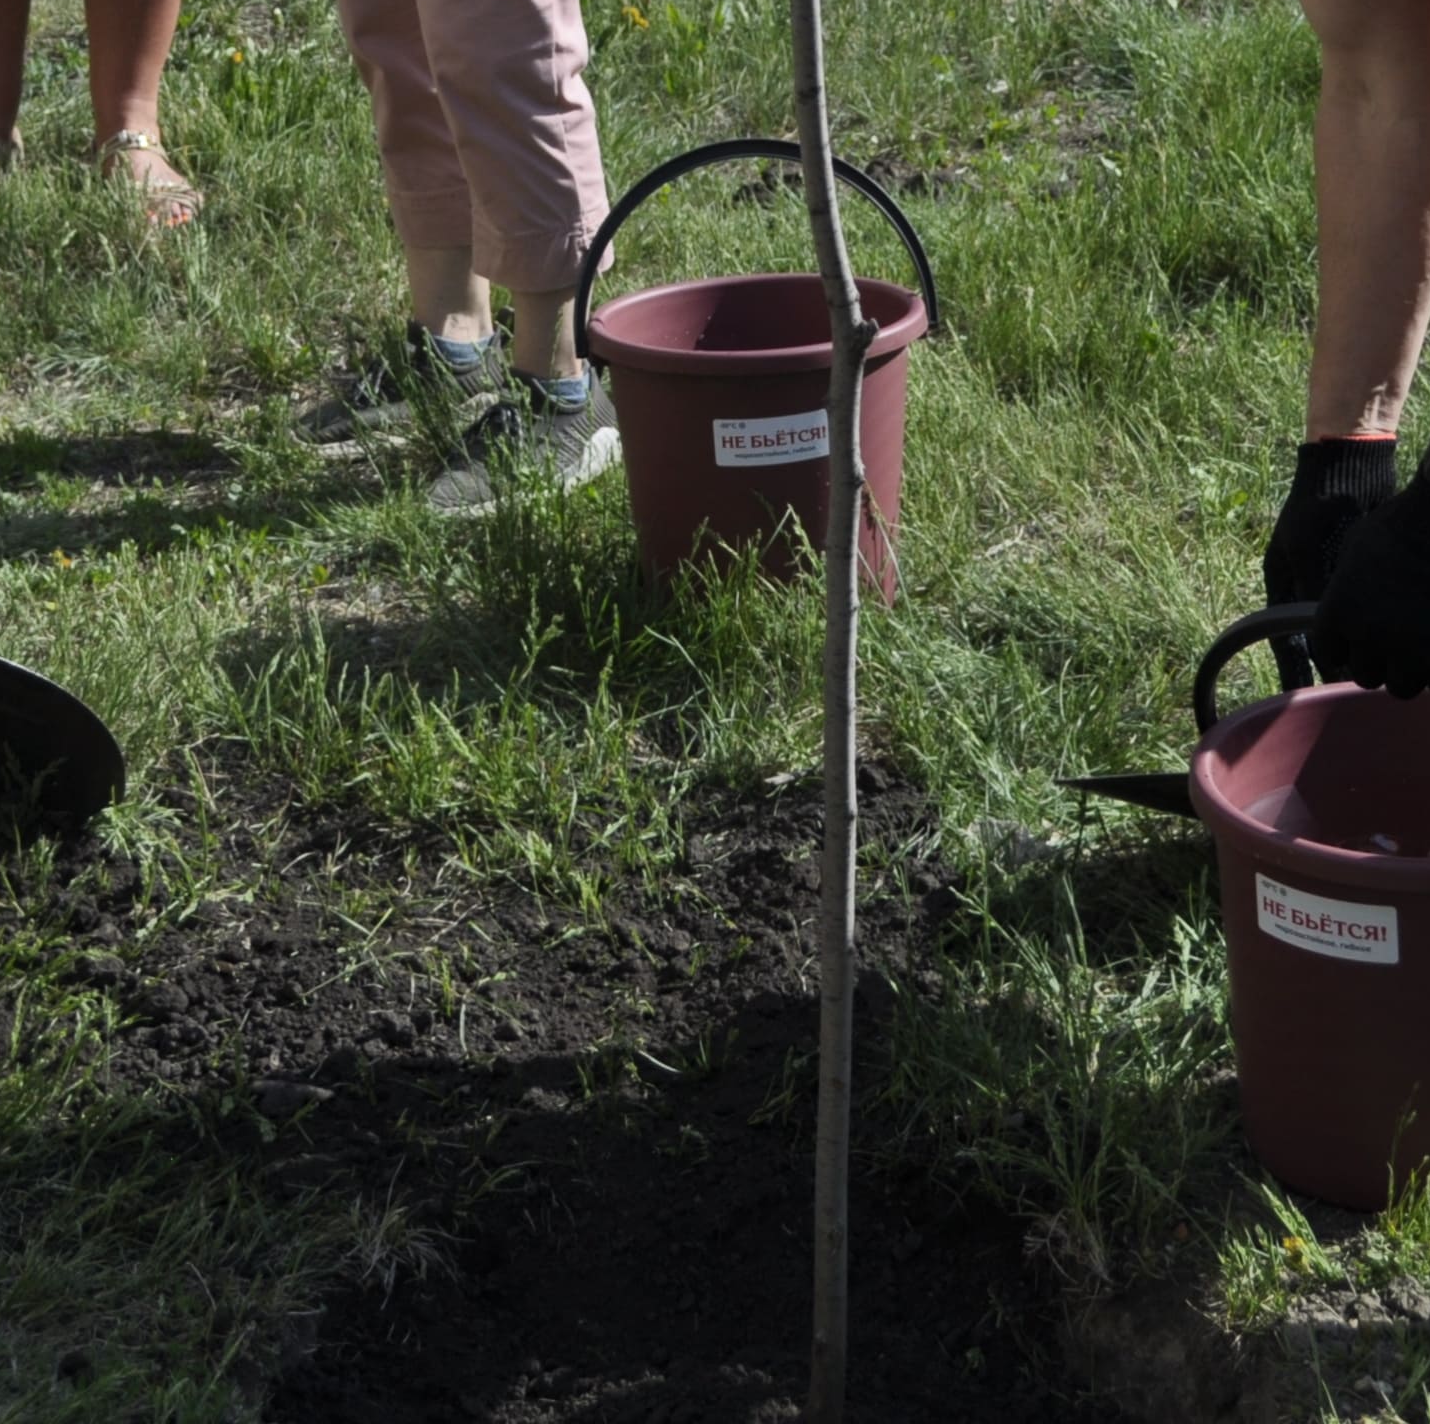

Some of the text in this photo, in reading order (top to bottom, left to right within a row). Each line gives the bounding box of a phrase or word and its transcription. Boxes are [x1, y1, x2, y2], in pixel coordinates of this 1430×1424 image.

[722, 426, 827, 448] НЕ БЬЁТСЯ!
[1262, 895, 1387, 942] НЕ БЬЁТСЯ!
